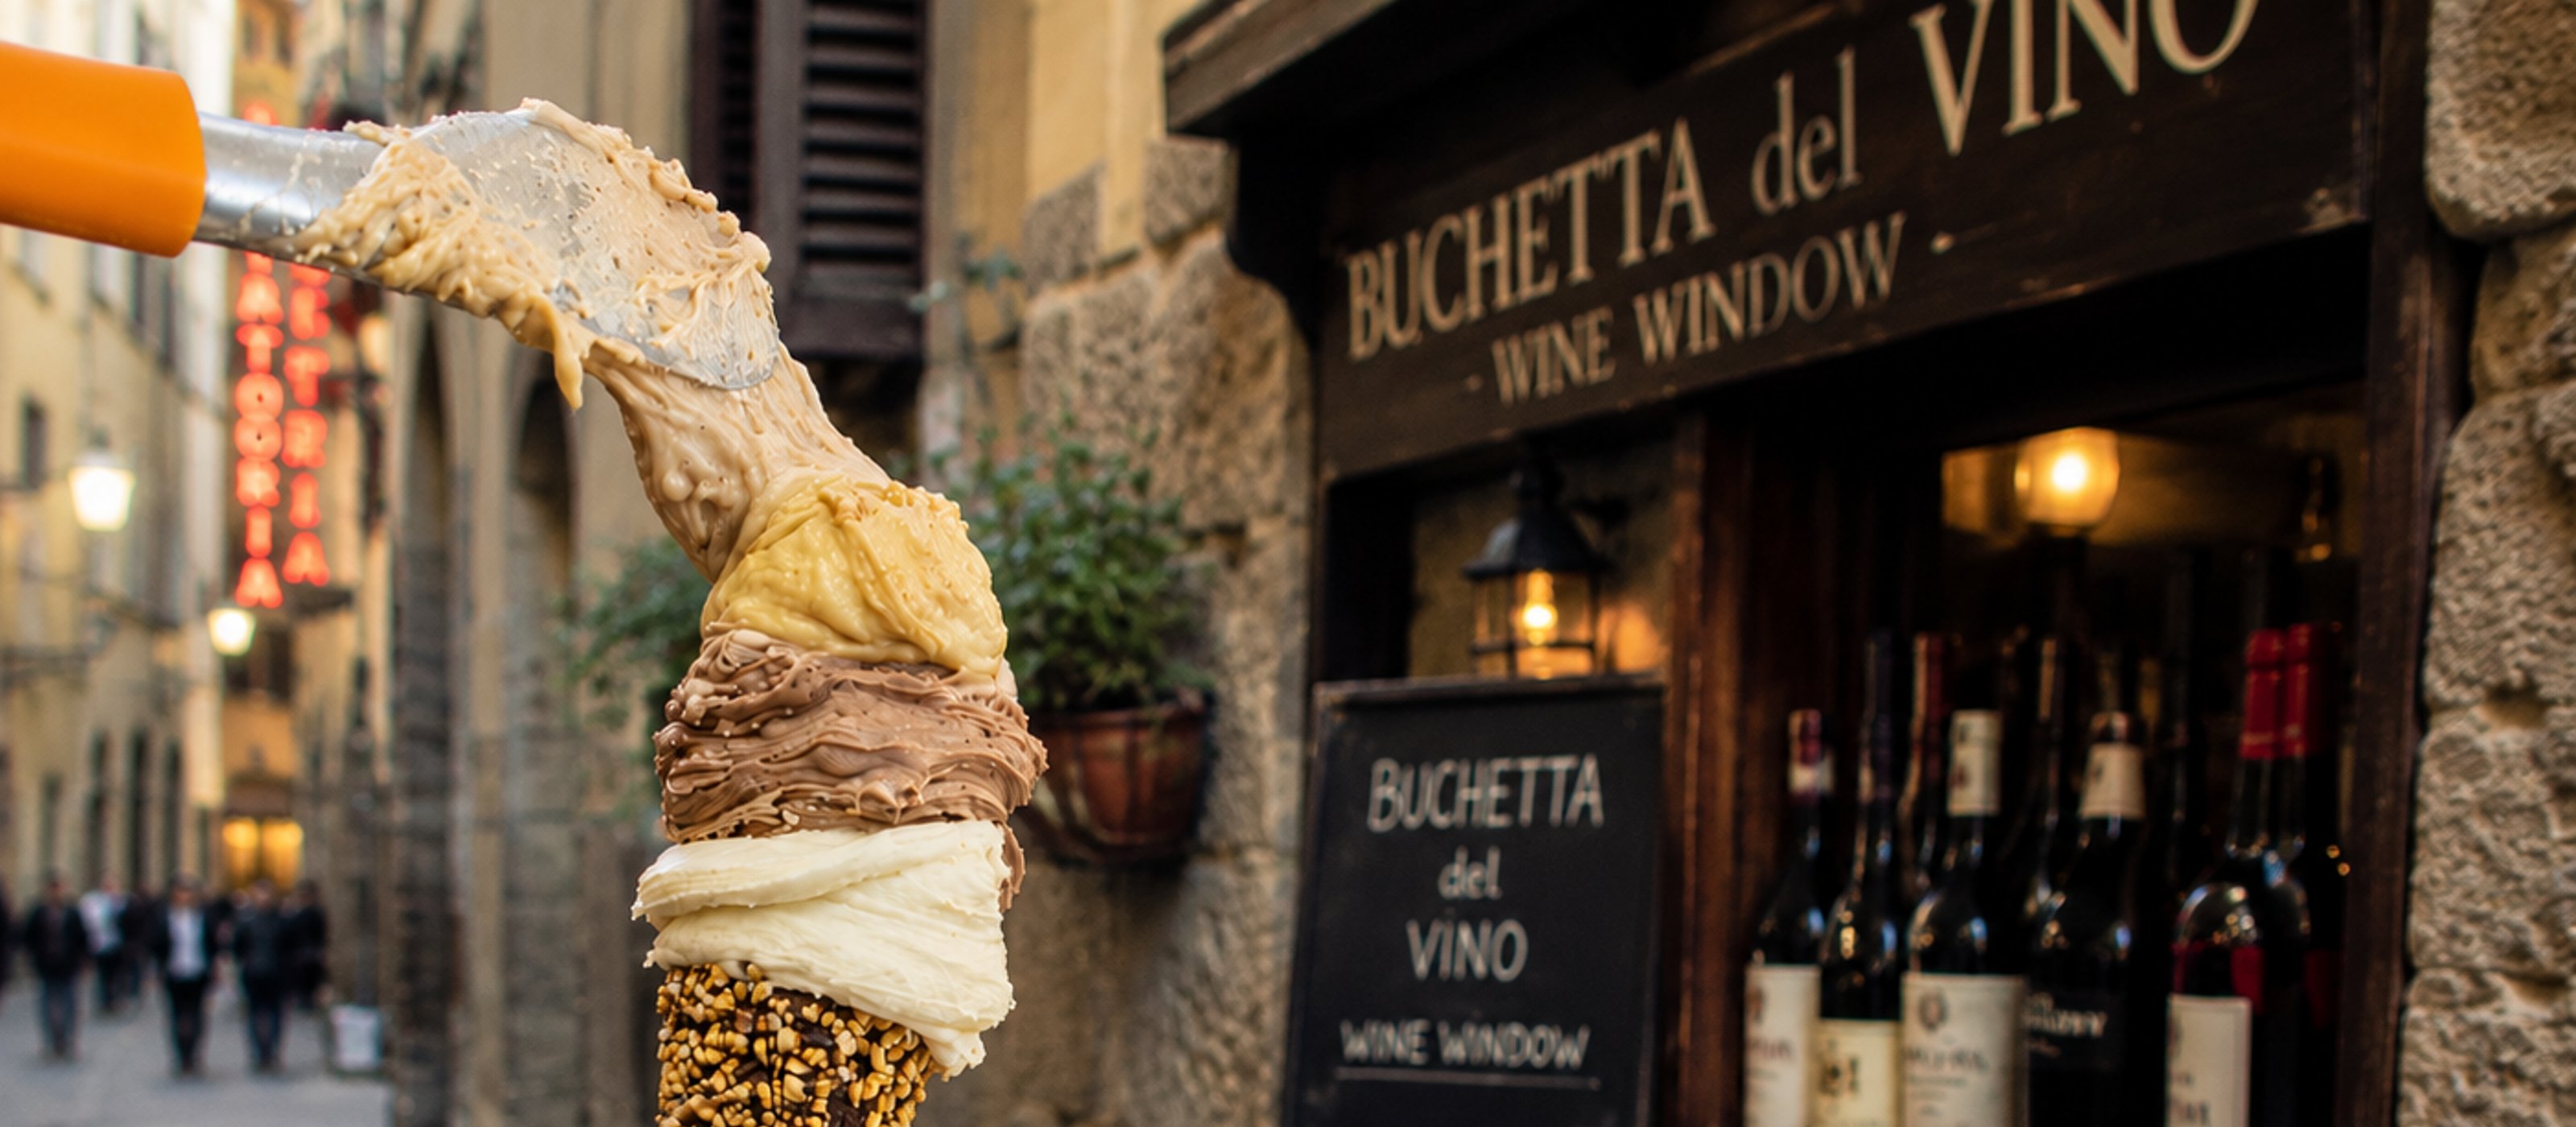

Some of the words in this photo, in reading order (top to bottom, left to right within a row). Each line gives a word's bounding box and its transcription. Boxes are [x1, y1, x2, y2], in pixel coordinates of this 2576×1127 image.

[1348, 118, 1713, 360] BUCHETTA
[1752, 50, 1860, 214] del
[1491, 306, 1615, 402] WINE
[1634, 213, 1905, 365] WINDOW
[1368, 753, 1604, 832] BUCHETTA
[1438, 846, 1502, 899] del
[1406, 919, 1528, 982] VINO
[1340, 1019, 1431, 1065] WINE
[1437, 1022, 1591, 1068] WINDOW
